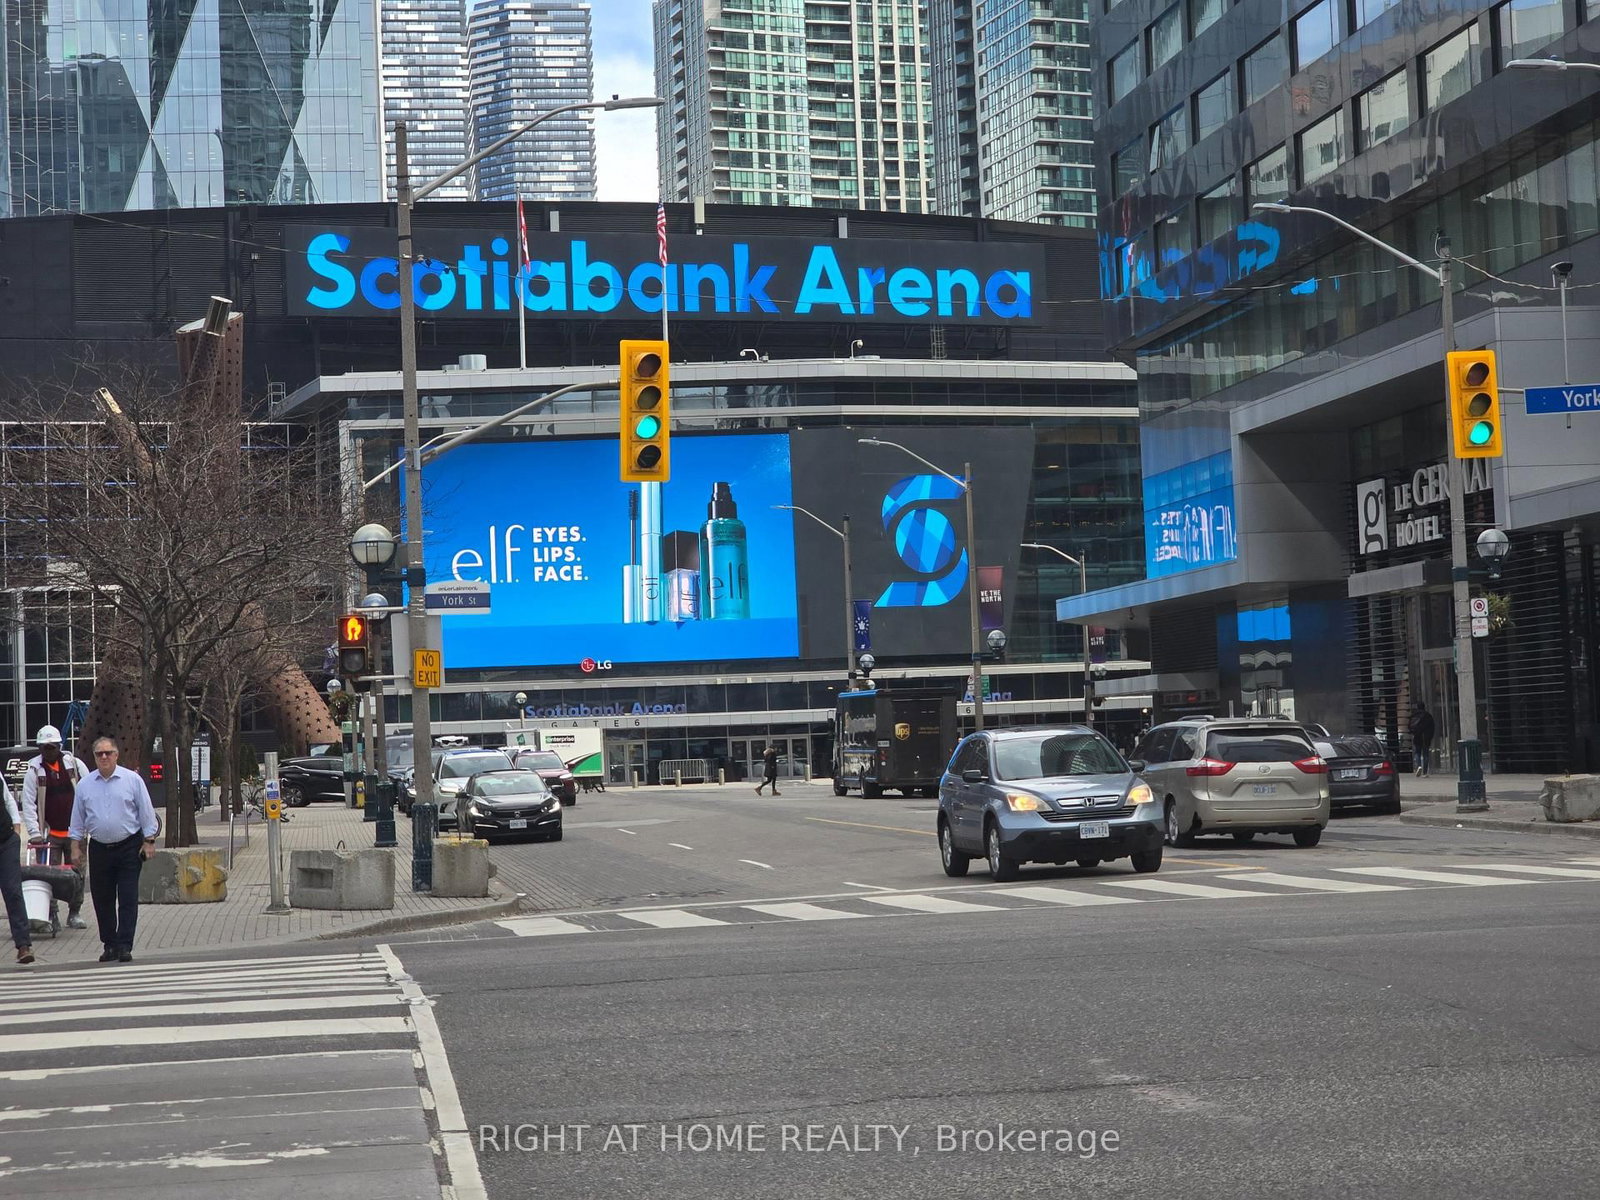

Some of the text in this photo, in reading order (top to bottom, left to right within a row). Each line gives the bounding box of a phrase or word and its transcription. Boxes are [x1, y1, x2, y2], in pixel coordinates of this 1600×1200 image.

[306, 233, 780, 313] Scotiabank
[794, 245, 1032, 318] Arena
[1393, 483, 1412, 511] LE
[532, 526, 587, 543] EYES.
[1396, 514, 1443, 547] HÔTEL
[533, 545, 581, 563] LIPS.
[533, 565, 589, 582] FACE.
[442, 595, 476, 606] York St
[422, 654, 434, 667] NO
[597, 660, 612, 670] LG
[418, 670, 438, 684] EXIT
[525, 701, 686, 718] Scotiabank Arena
[896, 728, 909, 738] ups
